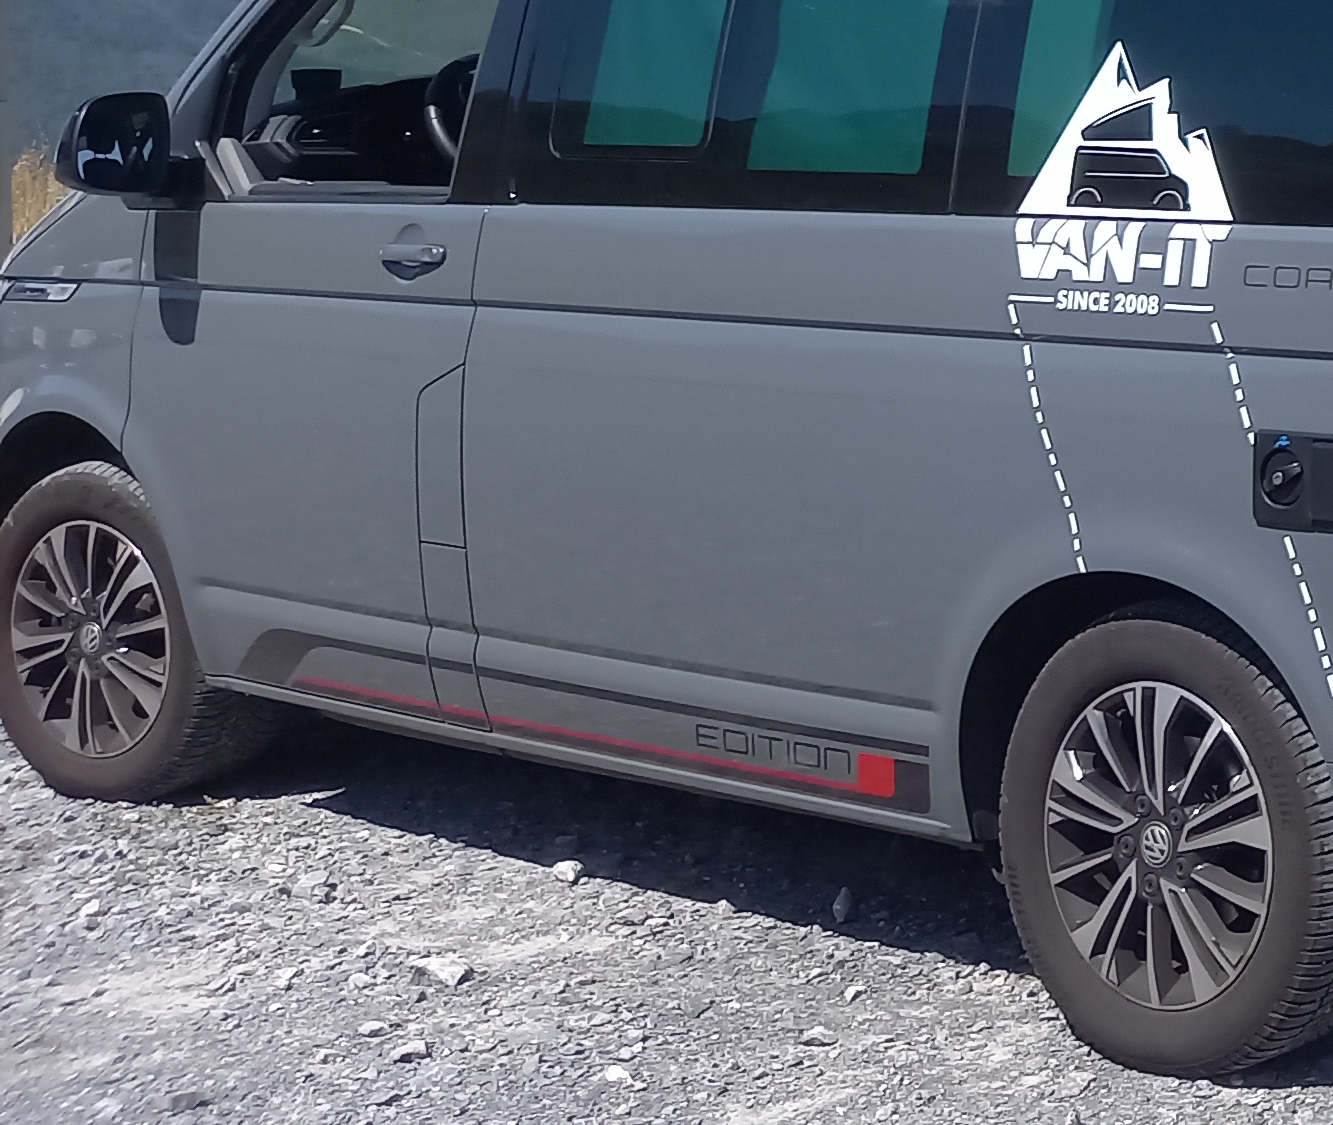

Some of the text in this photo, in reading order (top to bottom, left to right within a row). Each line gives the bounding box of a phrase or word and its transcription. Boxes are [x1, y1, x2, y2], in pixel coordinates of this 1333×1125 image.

[1014, 217, 1234, 289] VAN-IT
[1055, 289, 1160, 316] SINCE 2008
[695, 723, 851, 775] EDITION
